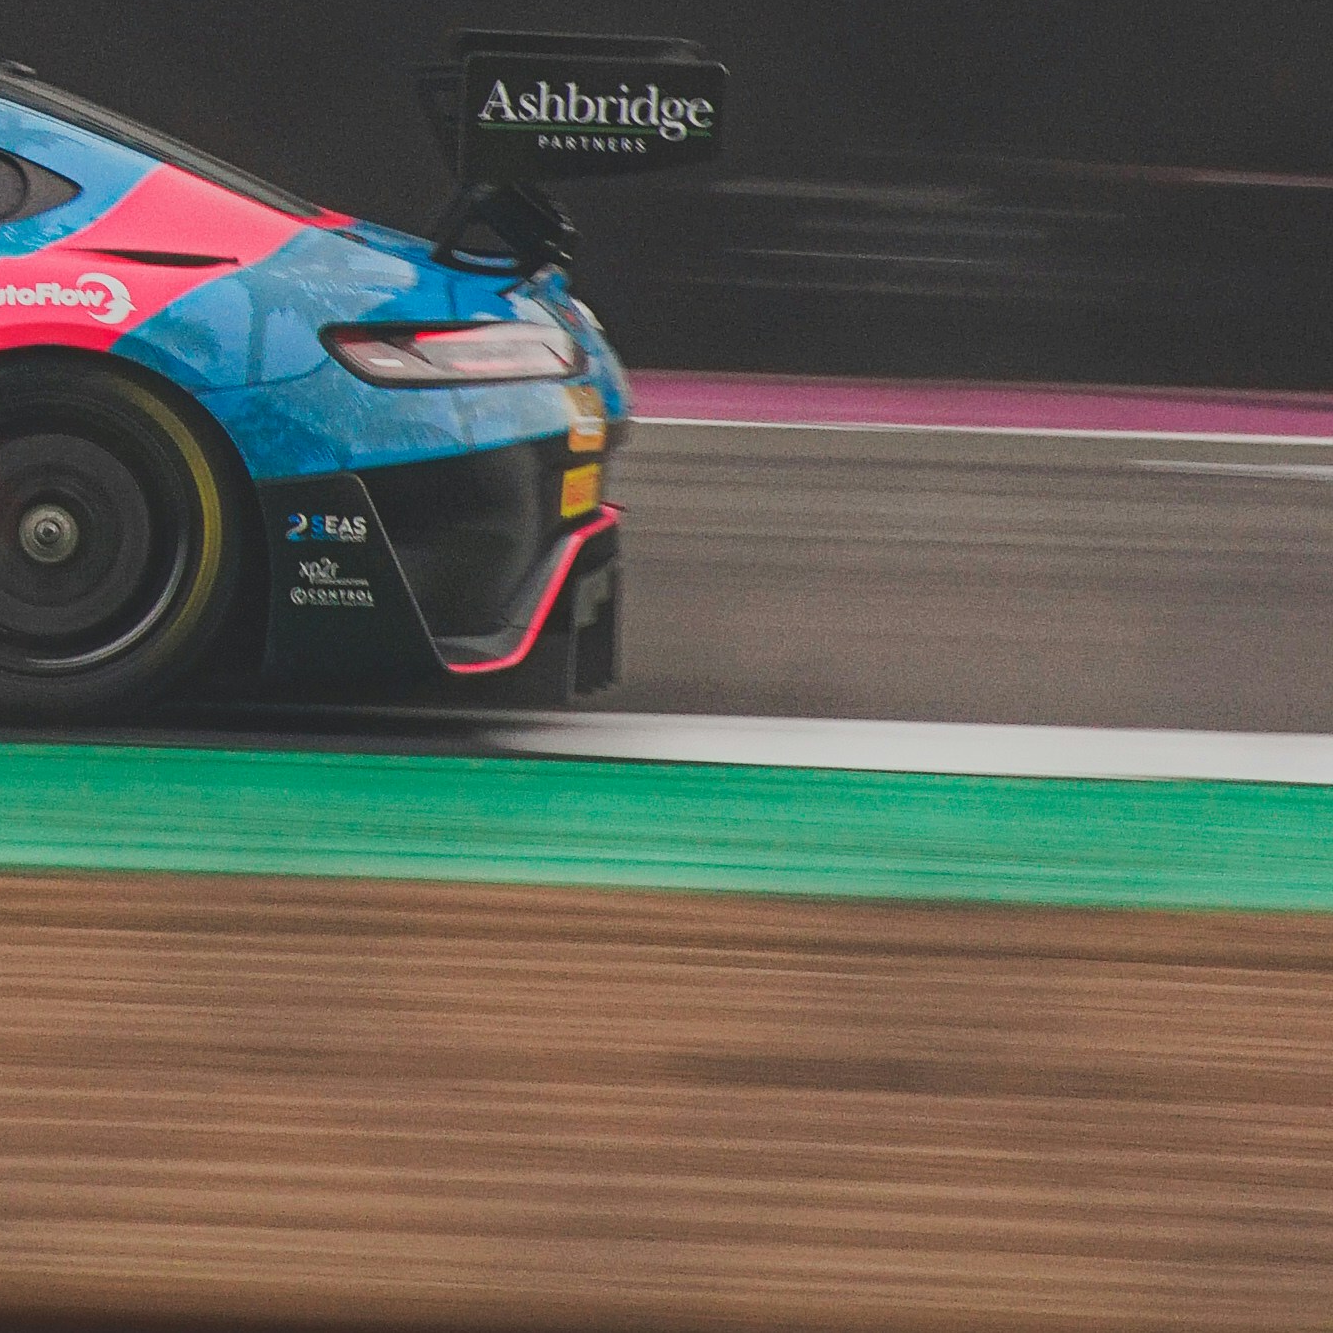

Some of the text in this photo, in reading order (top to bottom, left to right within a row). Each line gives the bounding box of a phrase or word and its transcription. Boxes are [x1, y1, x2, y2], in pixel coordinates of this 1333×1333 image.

[478, 79, 714, 141] Ashbridge
[537, 134, 647, 153] PARTNERS
[310, 515, 367, 537] SEAS
